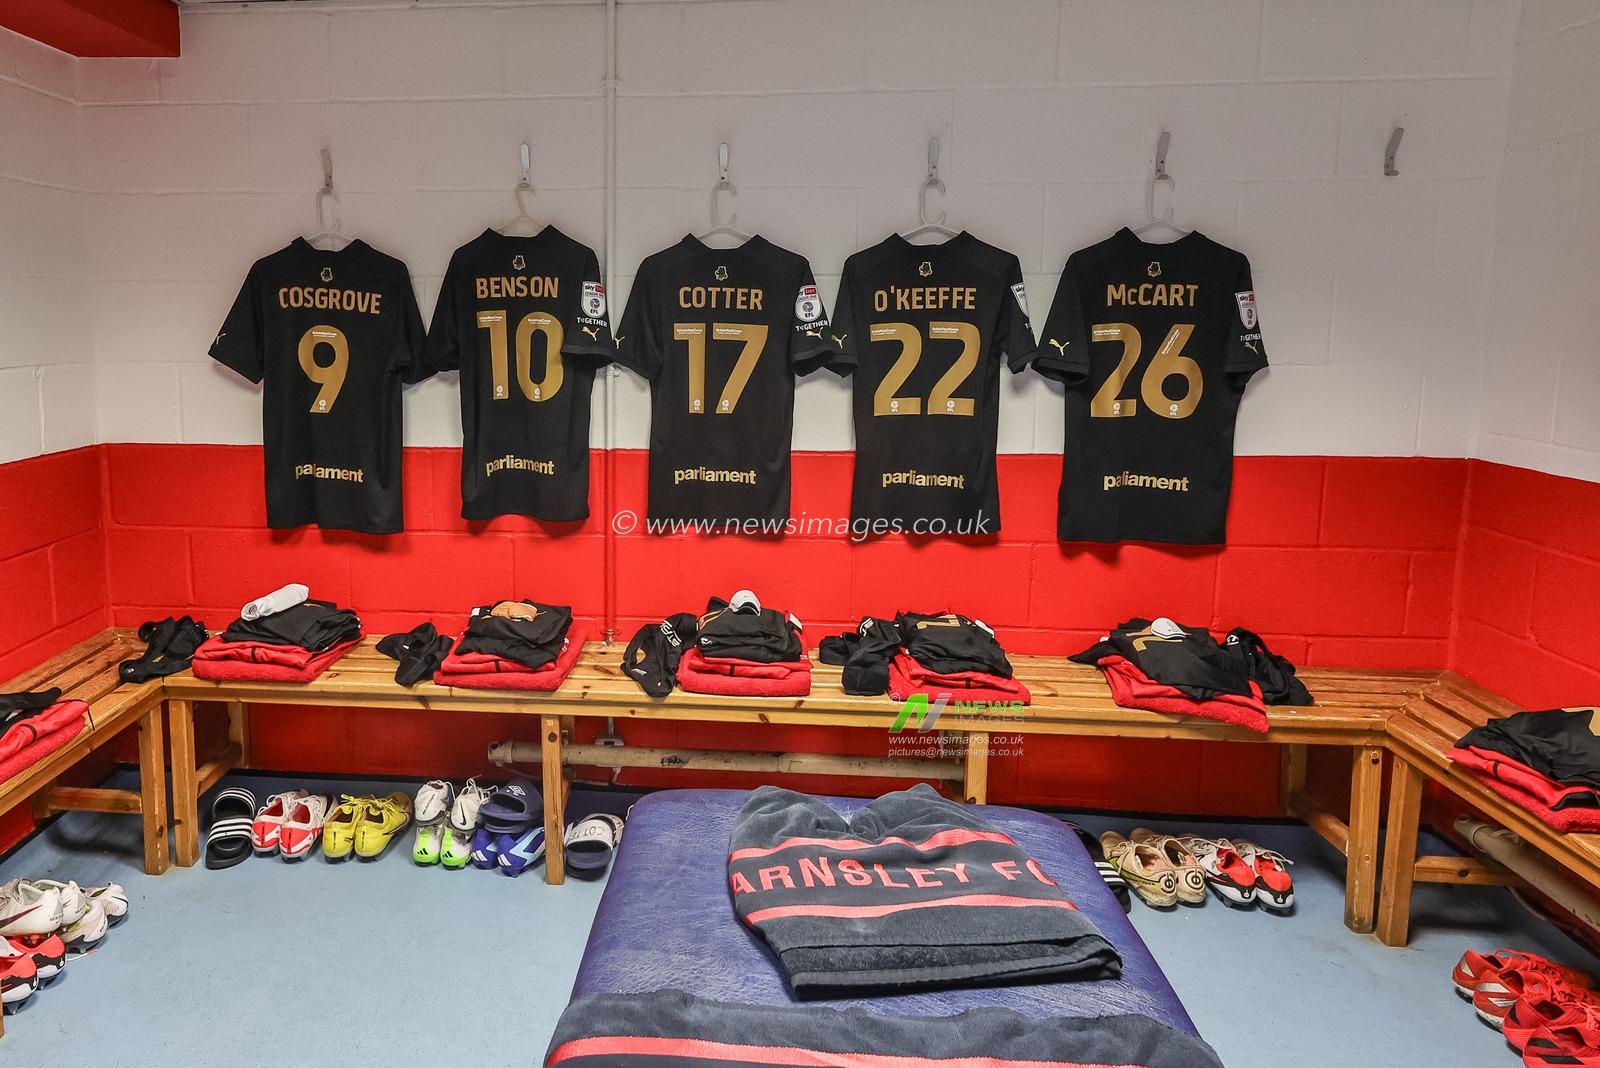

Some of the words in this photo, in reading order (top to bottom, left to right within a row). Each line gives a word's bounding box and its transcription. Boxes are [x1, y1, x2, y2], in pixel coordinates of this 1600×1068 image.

[278, 286, 382, 315] COSGROVE
[475, 276, 559, 299] BENSON
[679, 286, 764, 311] COTTER
[874, 285, 977, 312] O'KEEFFE
[1106, 283, 1199, 307] McCART
[298, 324, 349, 413] 9
[477, 309, 564, 402] 10
[674, 322, 769, 413] 17
[870, 321, 981, 416] 22
[1091, 323, 1204, 419] 26
[485, 454, 555, 477] parliament
[674, 466, 757, 485] parliament
[882, 469, 965, 490] parliament
